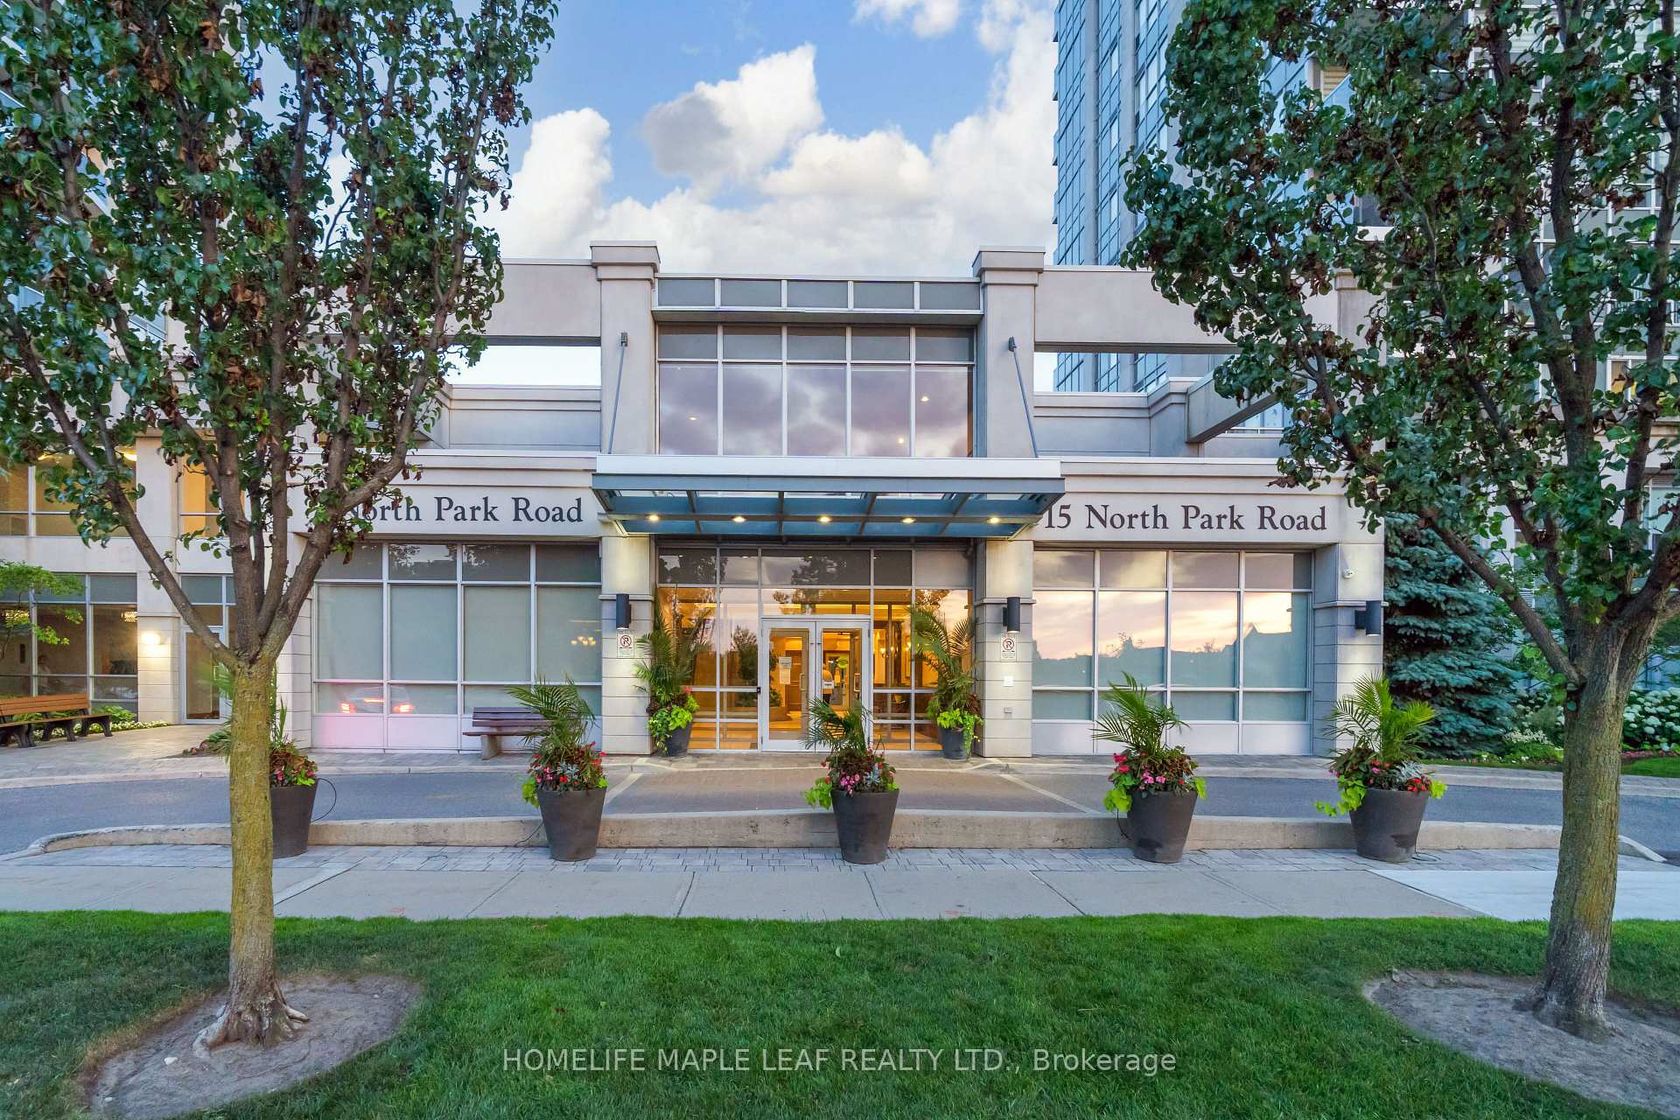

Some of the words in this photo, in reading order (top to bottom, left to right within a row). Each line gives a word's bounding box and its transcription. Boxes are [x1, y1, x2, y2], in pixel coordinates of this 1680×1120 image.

[433, 496, 500, 522] Park
[511, 497, 584, 523] Road
[1044, 503, 1072, 529] 15
[1084, 503, 1169, 530] North
[1180, 504, 1246, 531] Park
[1257, 505, 1328, 532] Road
